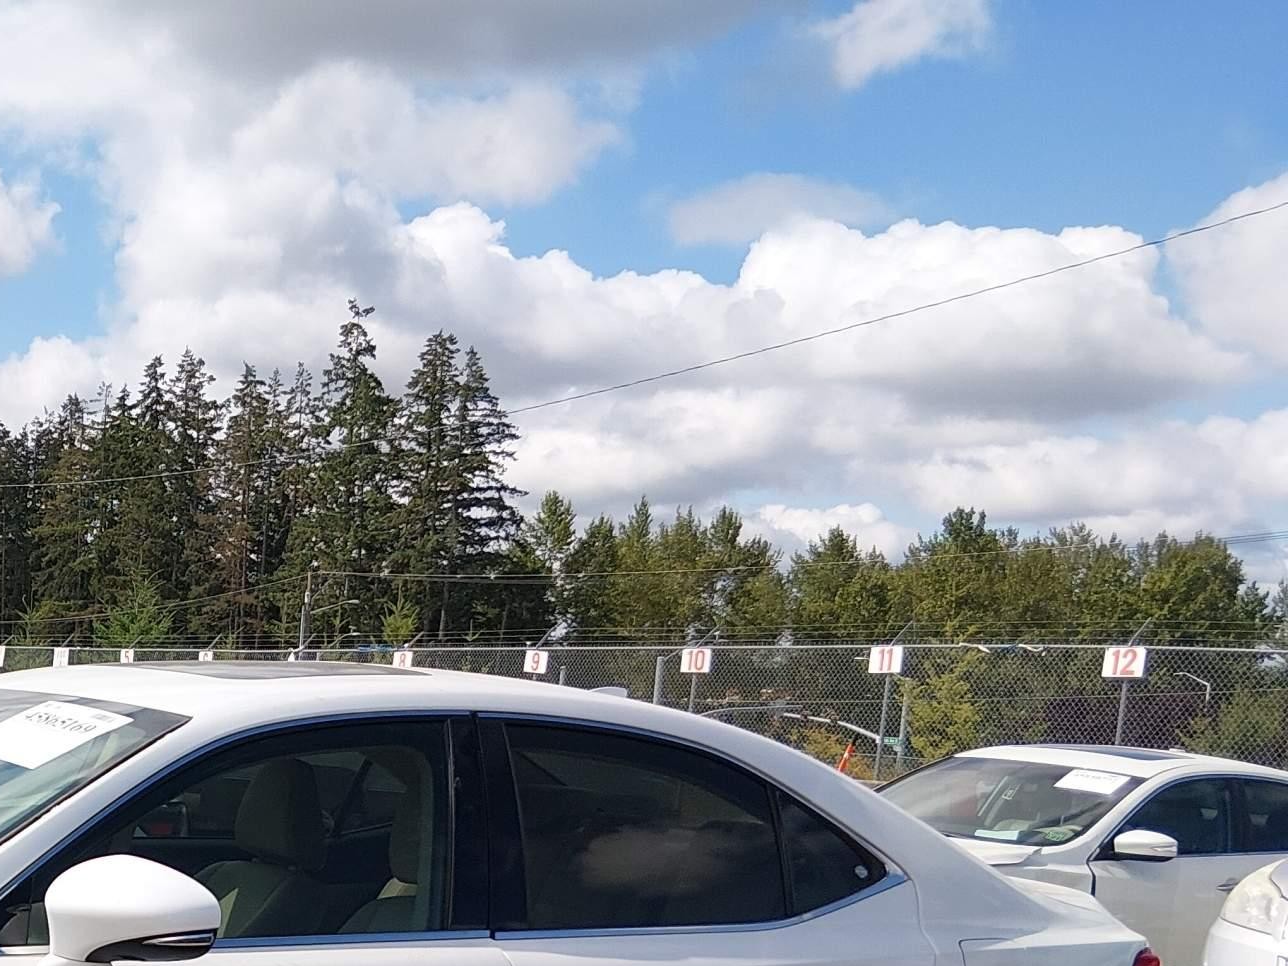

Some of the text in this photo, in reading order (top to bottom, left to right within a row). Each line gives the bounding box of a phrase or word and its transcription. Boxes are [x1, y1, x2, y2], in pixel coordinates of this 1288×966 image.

[531, 652, 540, 671] 9
[687, 650, 705, 670] 10
[878, 648, 893, 671] 11
[1112, 649, 1137, 675] 12
